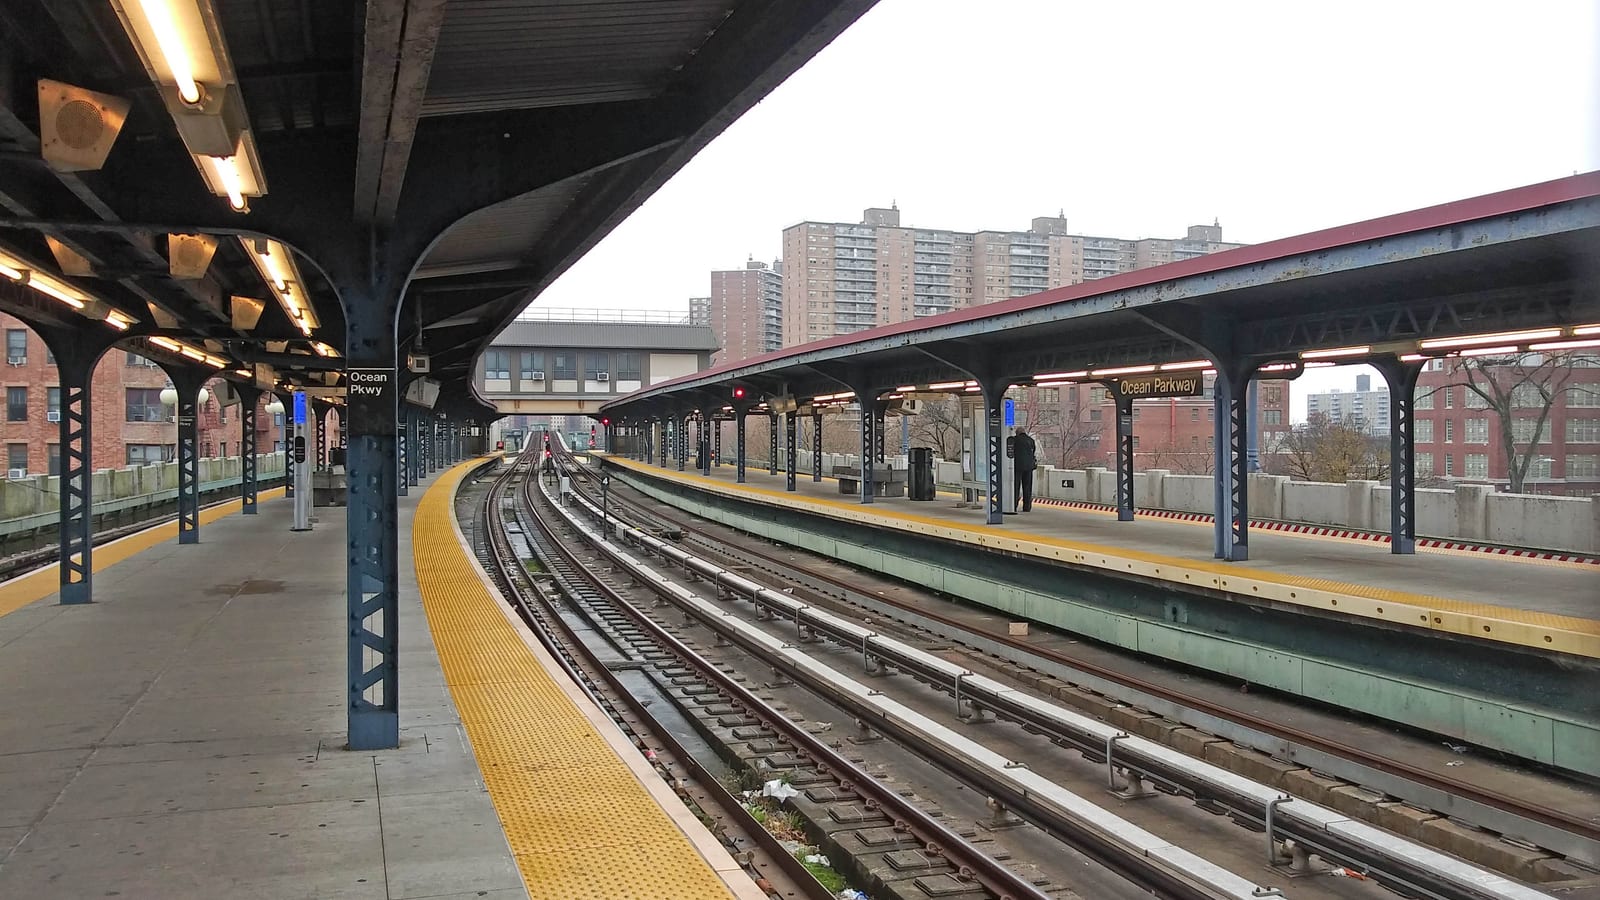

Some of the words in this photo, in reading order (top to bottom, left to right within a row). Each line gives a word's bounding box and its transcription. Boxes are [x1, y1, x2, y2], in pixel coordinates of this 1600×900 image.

[350, 372, 387, 382] Ocean
[350, 384, 382, 396] Pkwy
[1120, 380, 1151, 395] Ocean
[1154, 377, 1197, 394] Parkway
